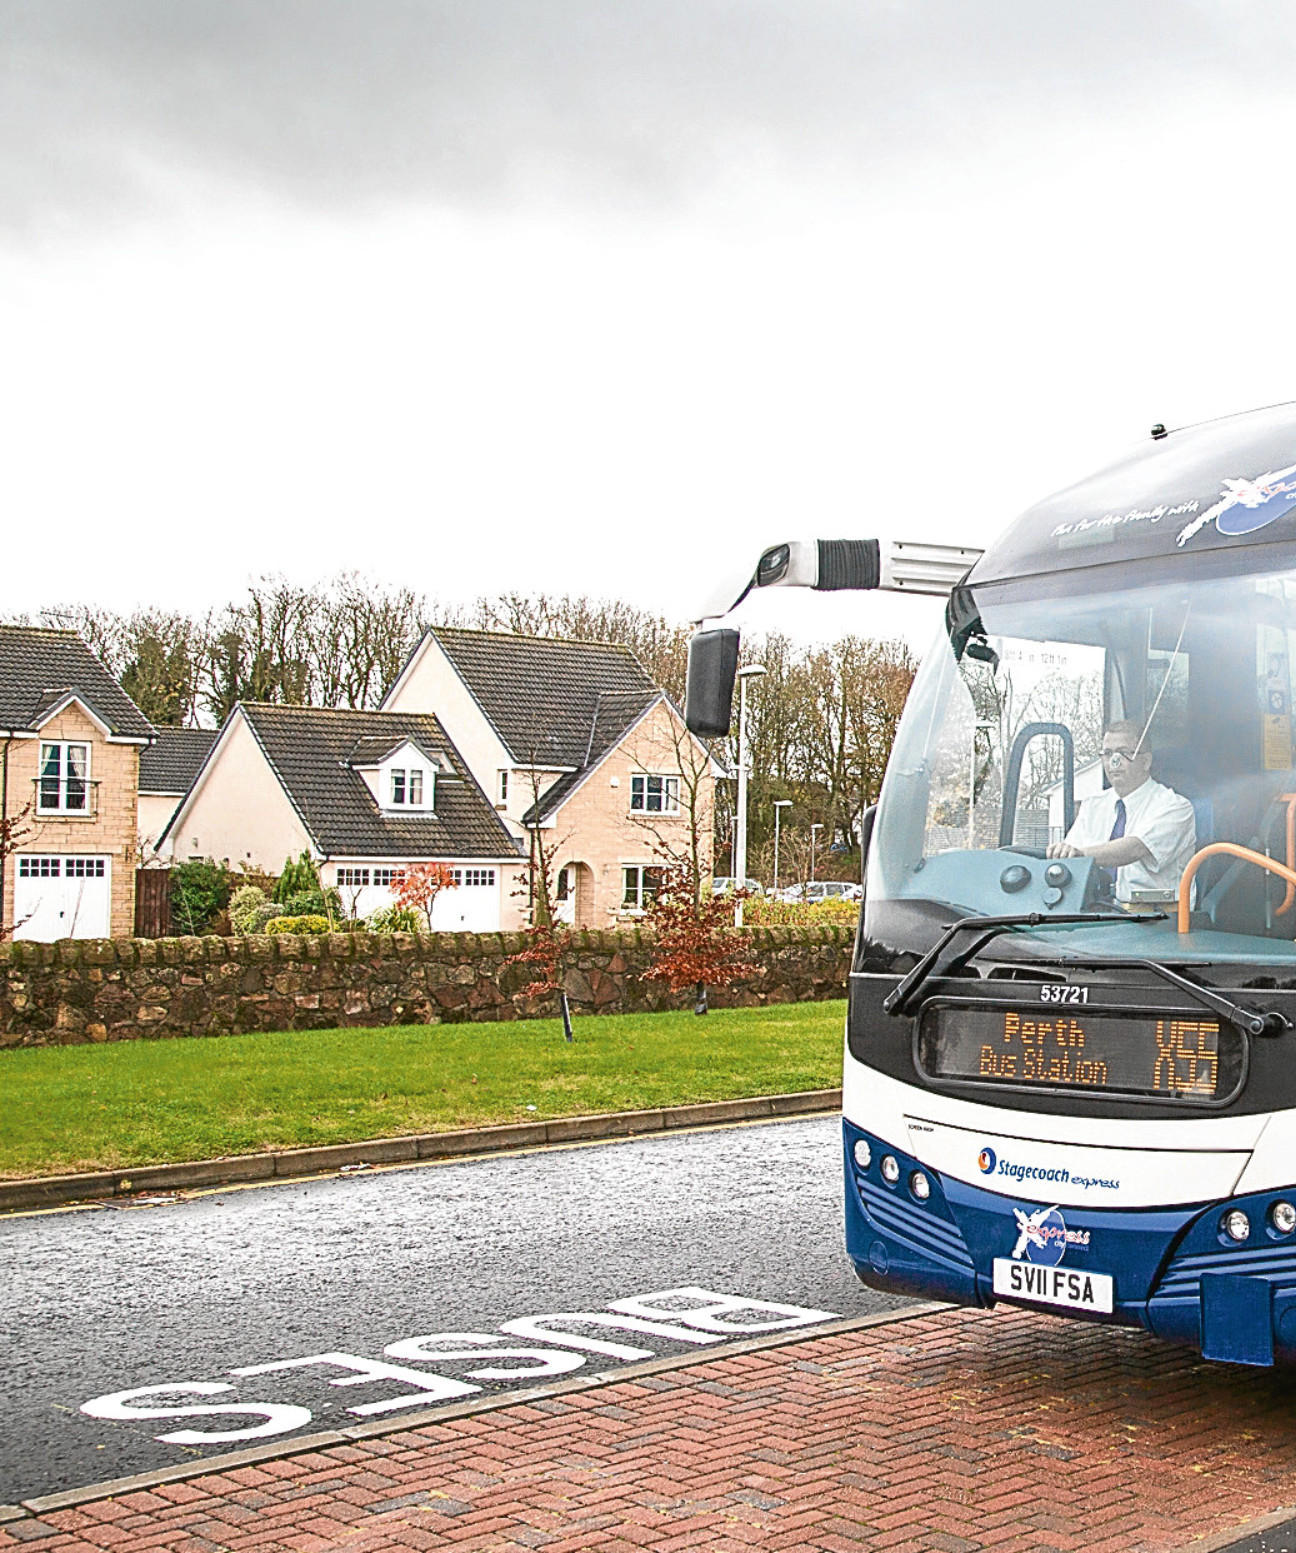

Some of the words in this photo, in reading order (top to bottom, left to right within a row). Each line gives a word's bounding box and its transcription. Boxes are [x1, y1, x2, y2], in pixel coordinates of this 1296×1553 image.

[1040, 985, 1089, 1004] 53721
[1004, 1011, 1085, 1048] Perth
[979, 1044, 1018, 1077] Bus
[1022, 1048, 1107, 1085] Station
[1153, 1020, 1220, 1095] X55
[997, 1159, 1070, 1183] Stagecoach
[1070, 1176, 1120, 1190] express
[1010, 1264, 1047, 1296] SV11
[1053, 1271, 1095, 1304] FSA
